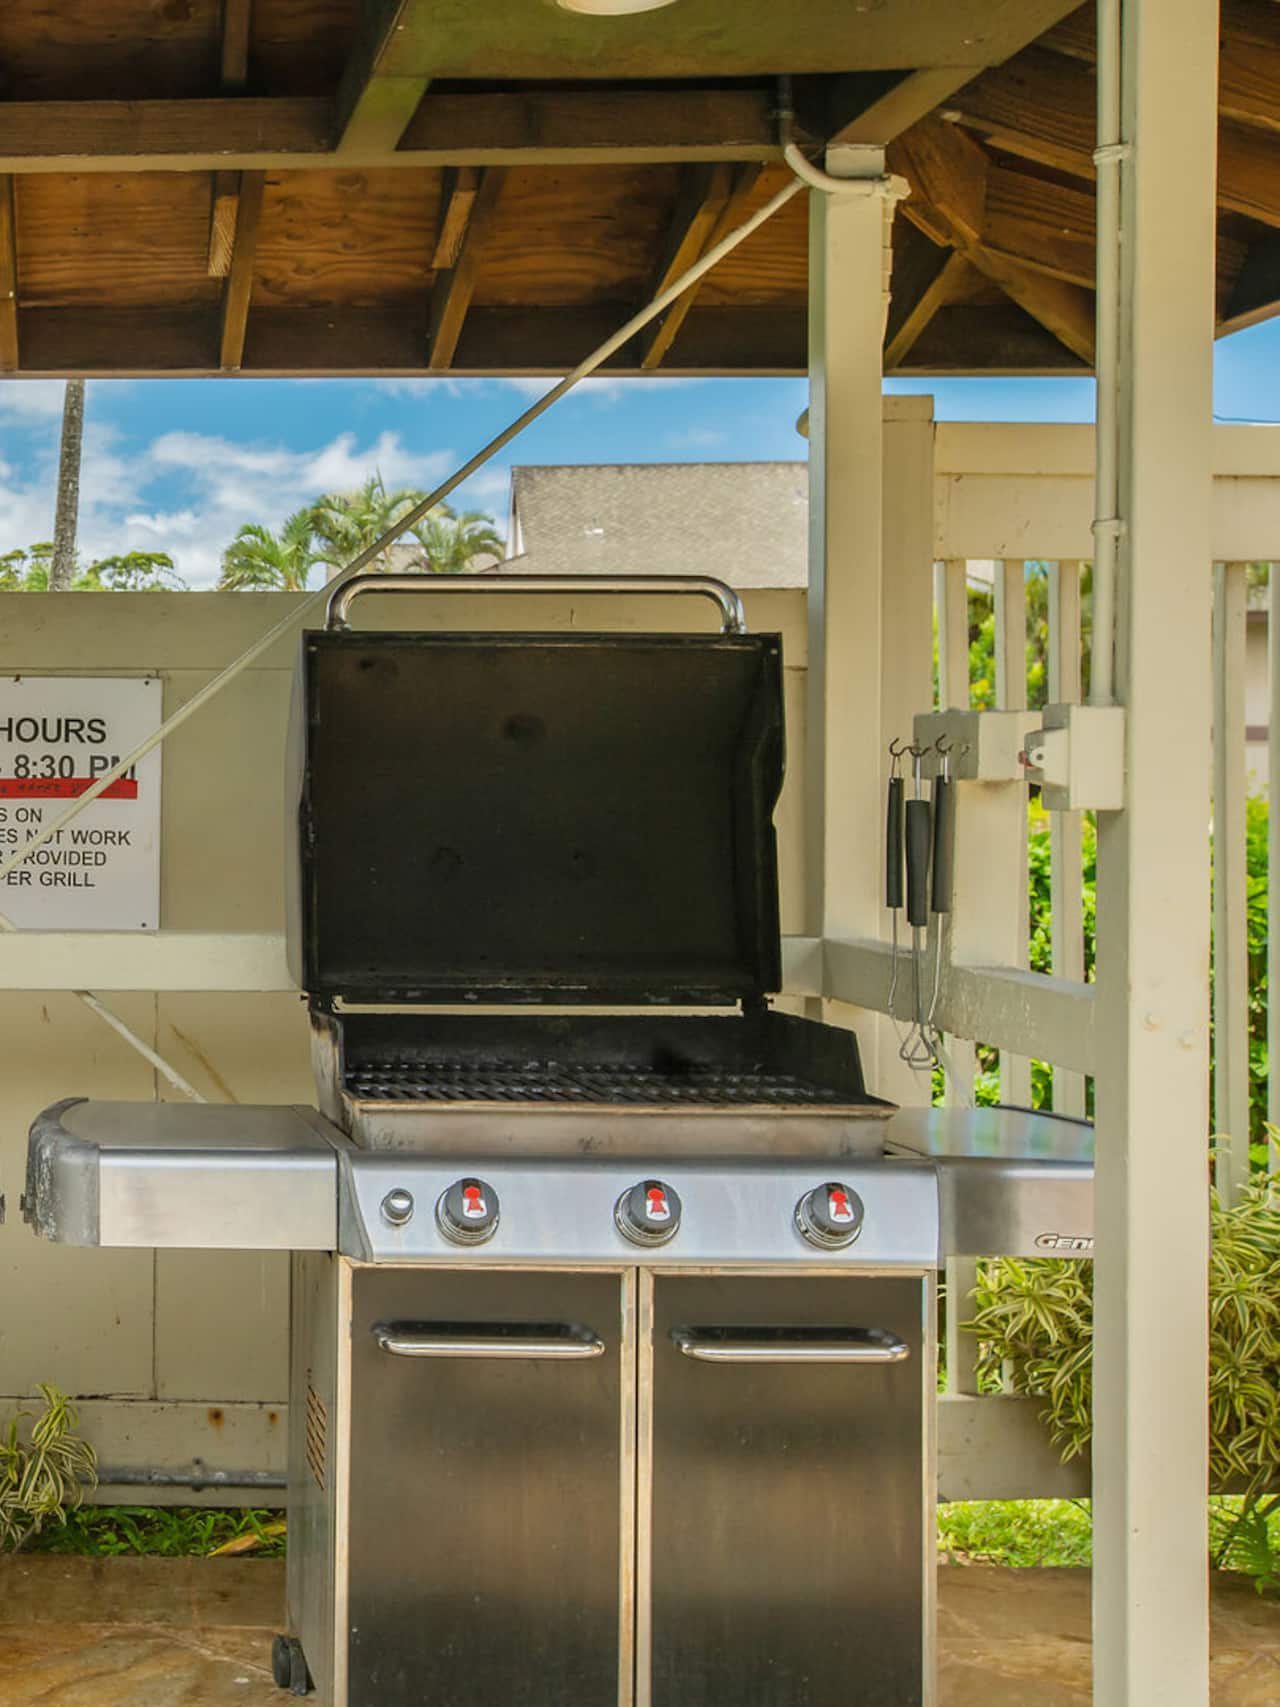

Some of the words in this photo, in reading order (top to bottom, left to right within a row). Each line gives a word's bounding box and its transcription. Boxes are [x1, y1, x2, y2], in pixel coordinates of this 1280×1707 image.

[13, 754, 74, 779] 8:30
[15, 807, 42, 823] ON
[71, 829, 131, 846] WORK
[11, 849, 107, 866] ROVIDED
[39, 871, 96, 887] GRILL
